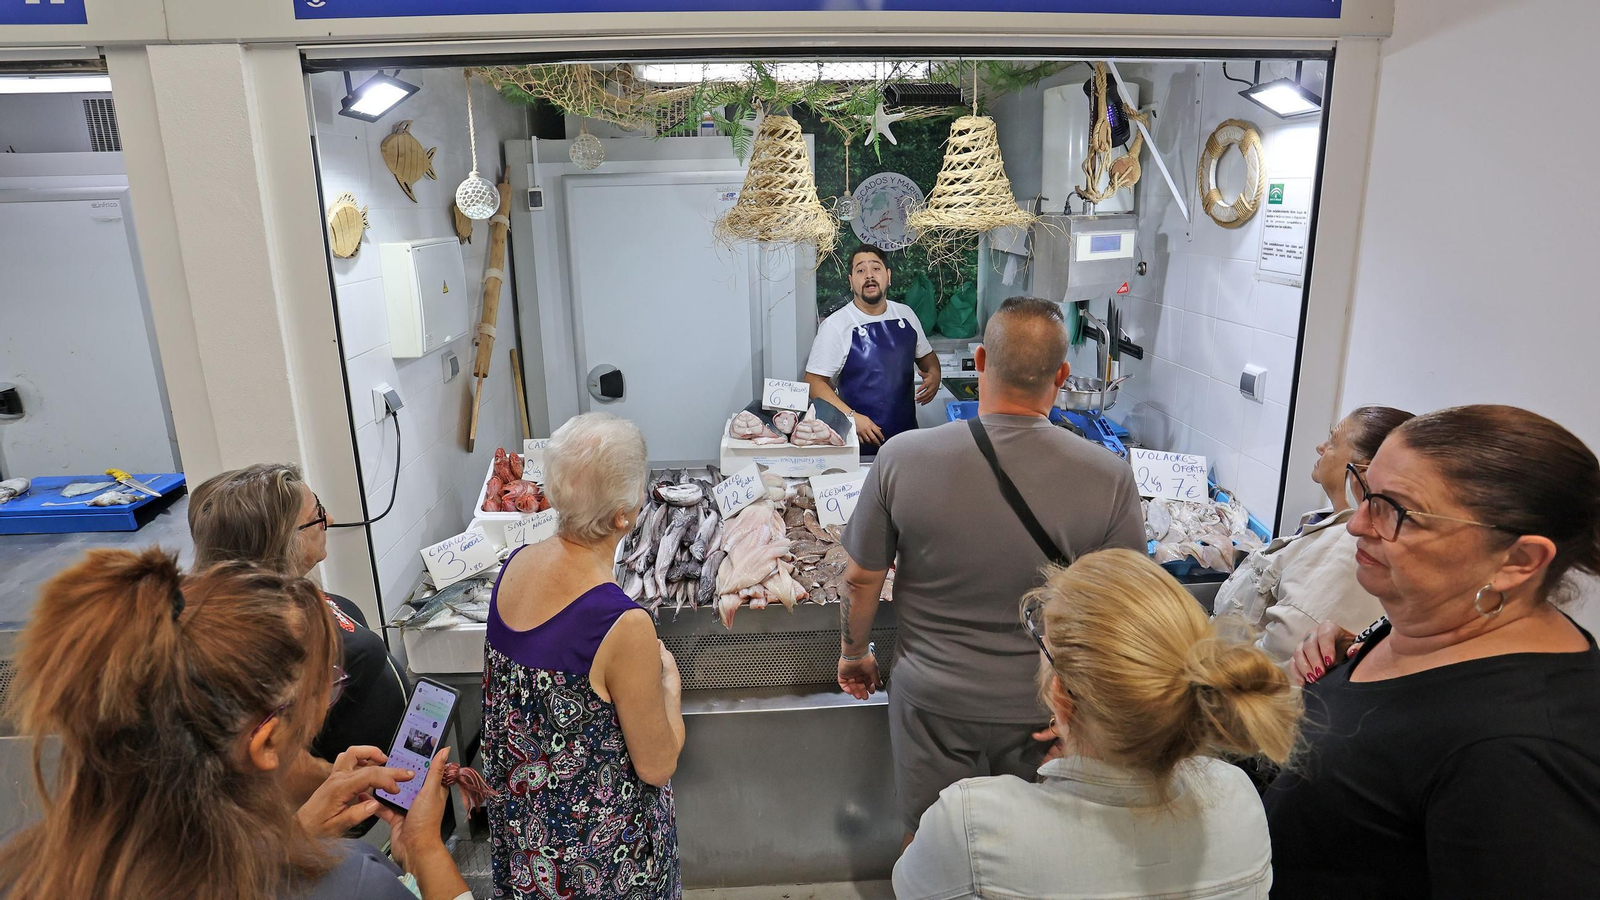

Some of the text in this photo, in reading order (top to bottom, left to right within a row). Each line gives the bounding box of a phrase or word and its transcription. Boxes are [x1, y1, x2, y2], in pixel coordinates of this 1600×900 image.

[857, 176, 922, 202] SCADOS Y MARIS
[860, 232, 870, 243] MI
[770, 388, 784, 406] 6
[528, 440, 548, 450] CAB
[1172, 463, 1206, 474] OFERTA
[717, 474, 740, 494] GALLO
[723, 490, 743, 512] 12
[826, 497, 845, 522] 9
[515, 528, 526, 545] 4
[438, 550, 467, 581] 3
